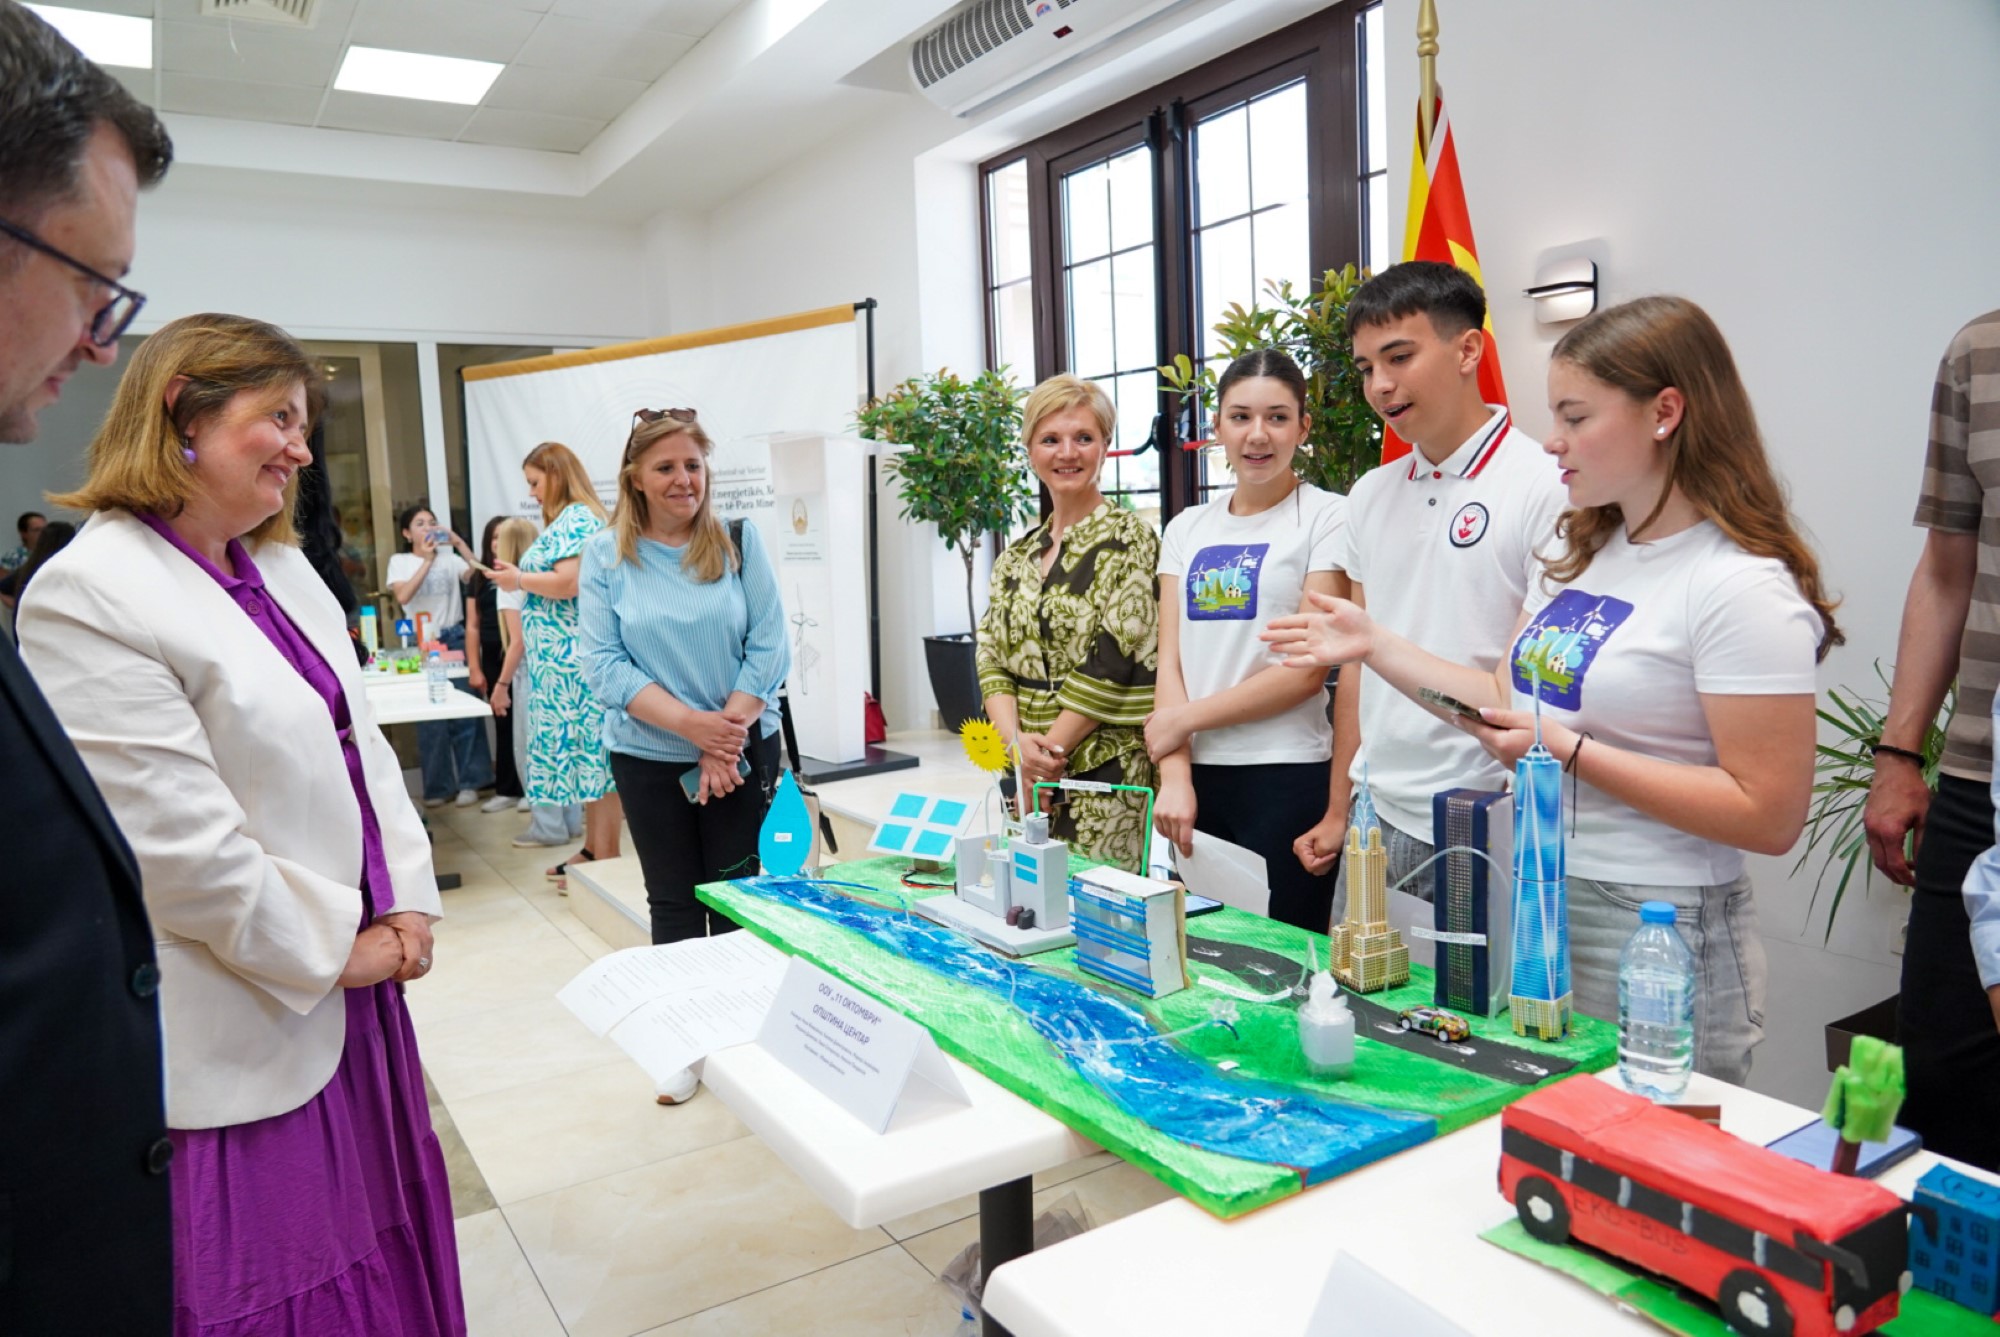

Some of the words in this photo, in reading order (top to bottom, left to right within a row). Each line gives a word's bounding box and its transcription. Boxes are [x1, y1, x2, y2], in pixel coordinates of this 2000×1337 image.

[736, 499, 755, 510] Para
[813, 1004, 844, 1030] ОПШТИНА
[843, 1024, 870, 1045] ЦЕНТАР
